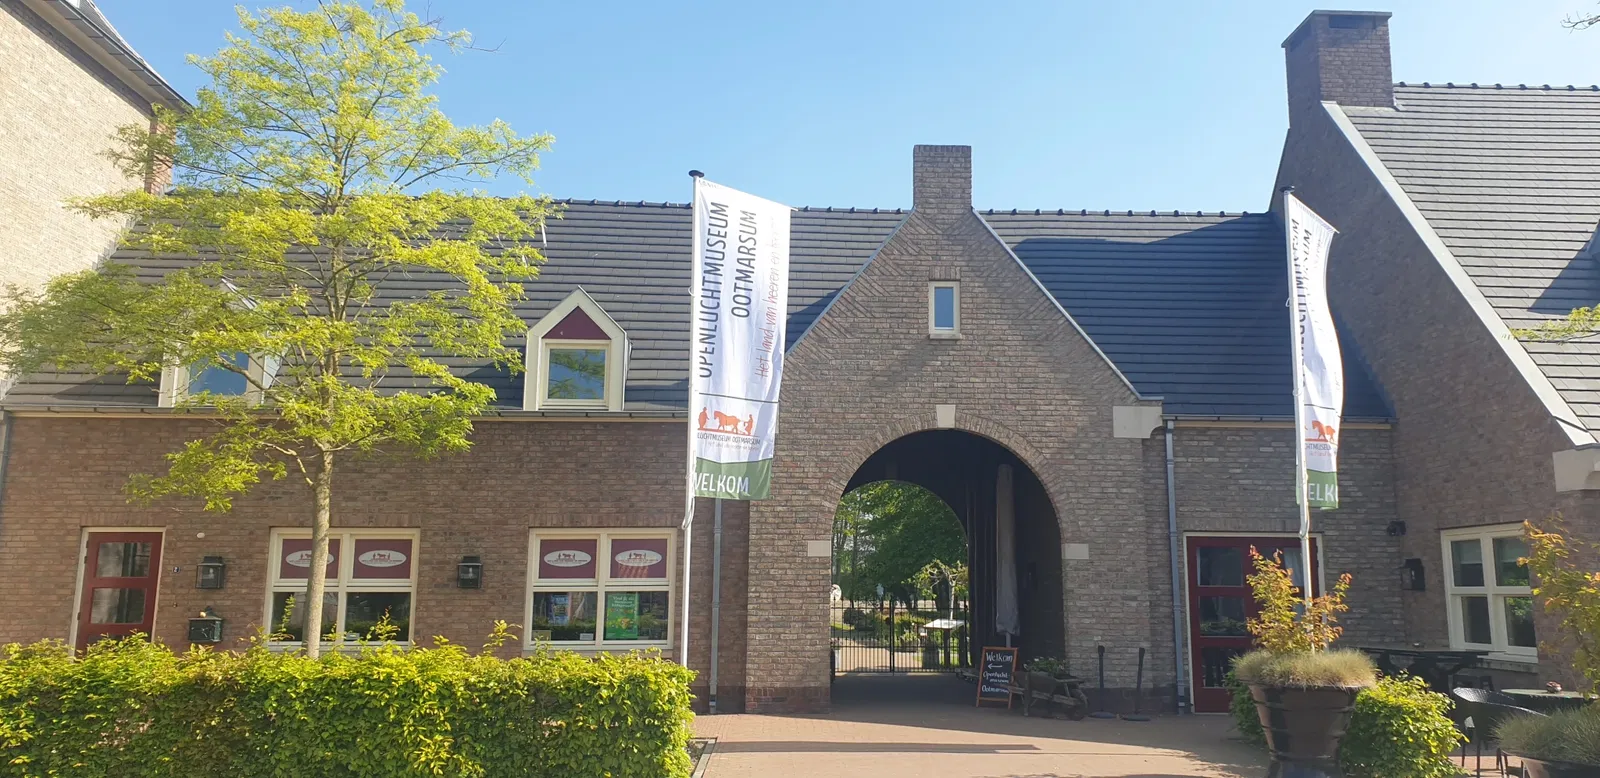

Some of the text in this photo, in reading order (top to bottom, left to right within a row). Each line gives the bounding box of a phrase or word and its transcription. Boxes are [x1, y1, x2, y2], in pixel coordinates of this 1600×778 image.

[731, 210, 757, 318] OOTMARSUM
[770, 250, 781, 265] en
[699, 202, 730, 378] OPENLUCHTMUSEUM
[762, 267, 780, 304] heeren
[766, 308, 777, 326] van
[756, 327, 774, 354] land
[755, 356, 770, 378] Het
[697, 432, 731, 442] LUCHTMUSEUM
[1307, 483, 1338, 502] ELK
[986, 652, 1013, 663] Welkom
